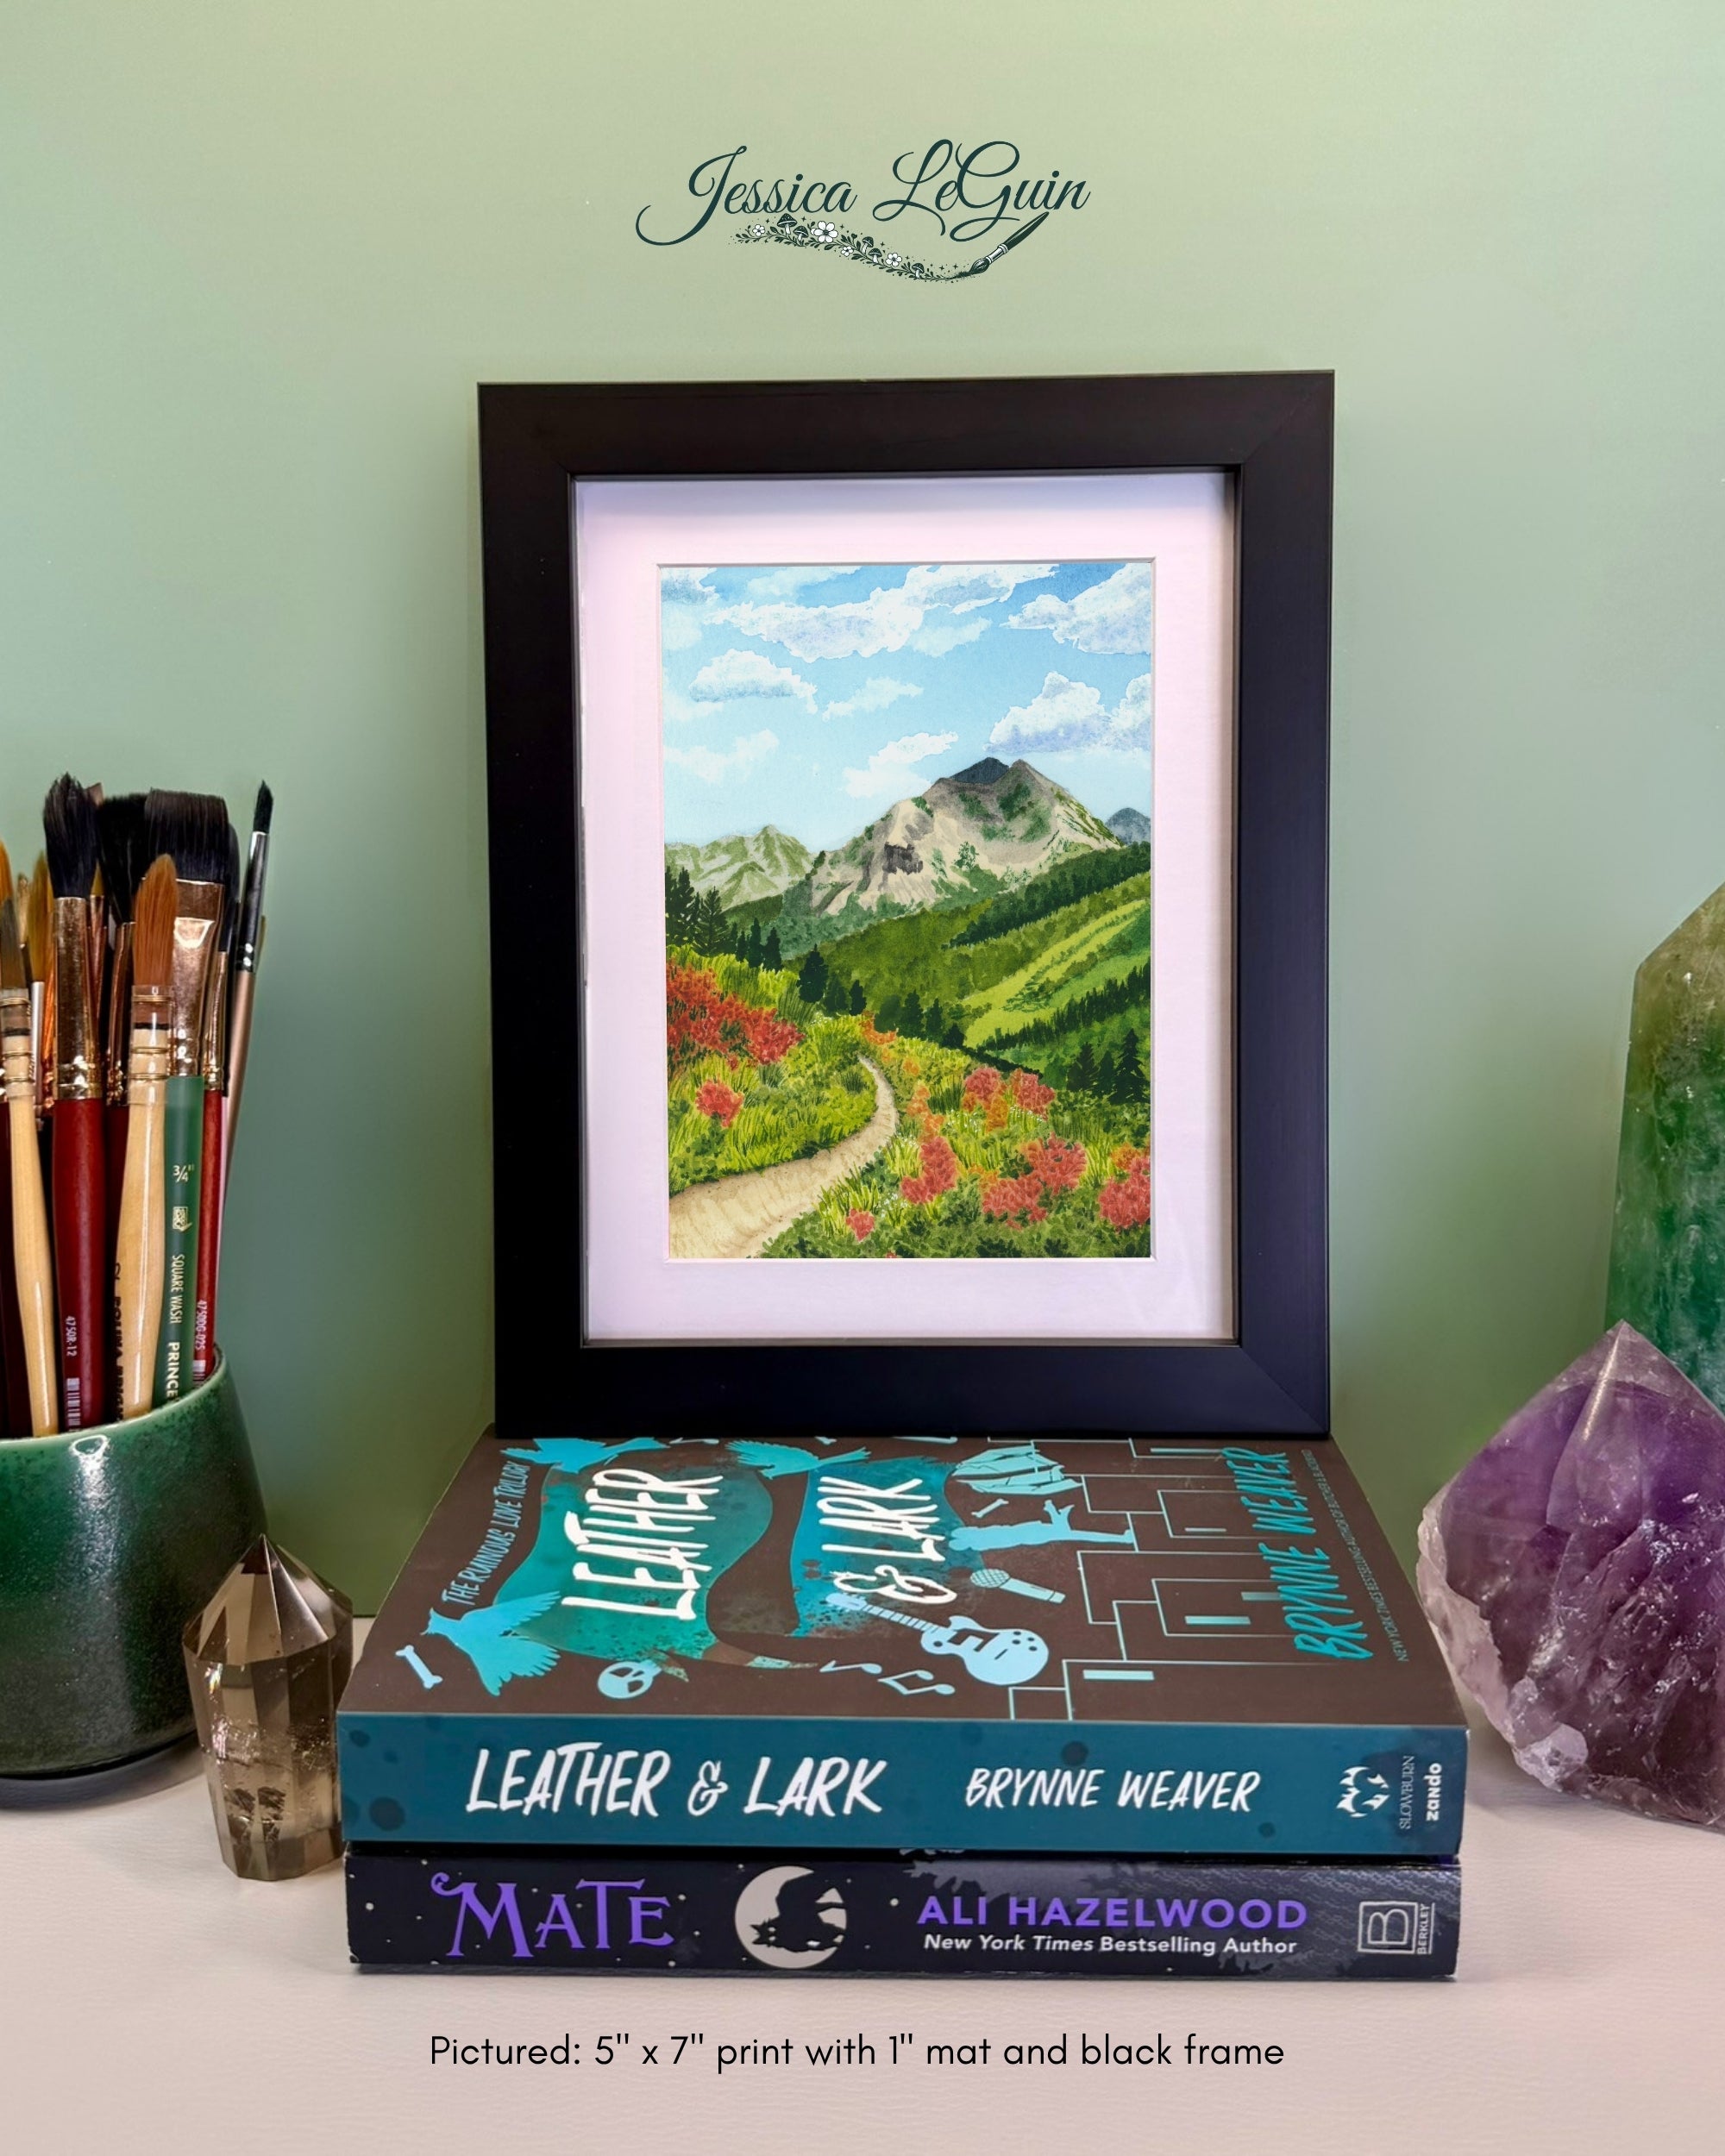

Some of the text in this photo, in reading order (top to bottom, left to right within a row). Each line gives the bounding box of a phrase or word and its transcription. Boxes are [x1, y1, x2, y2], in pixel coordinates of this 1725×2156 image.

[169, 1253, 185, 1325] SQUARE WASH
[166, 1341, 181, 1401] PRINCE
[442, 1460, 530, 1606] THE RUINOUS LOVE TRILOGY
[561, 1468, 724, 1620] LEATHER
[815, 1476, 957, 1605] & LARK
[1221, 1447, 1374, 1659] BRYNNE WEAVER
[467, 1741, 888, 1817] LEATHER & LARK
[965, 1767, 1261, 1812] BRYNNE WEAVER
[1399, 1755, 1414, 1830] SLOWBURN
[1424, 1762, 1442, 1821] zando
[917, 1896, 1307, 1929] ALI HAZELWOOD
[925, 1934, 1297, 1957] New York Times Bestselling Author
[1416, 1902, 1431, 1955] BERKLEY
